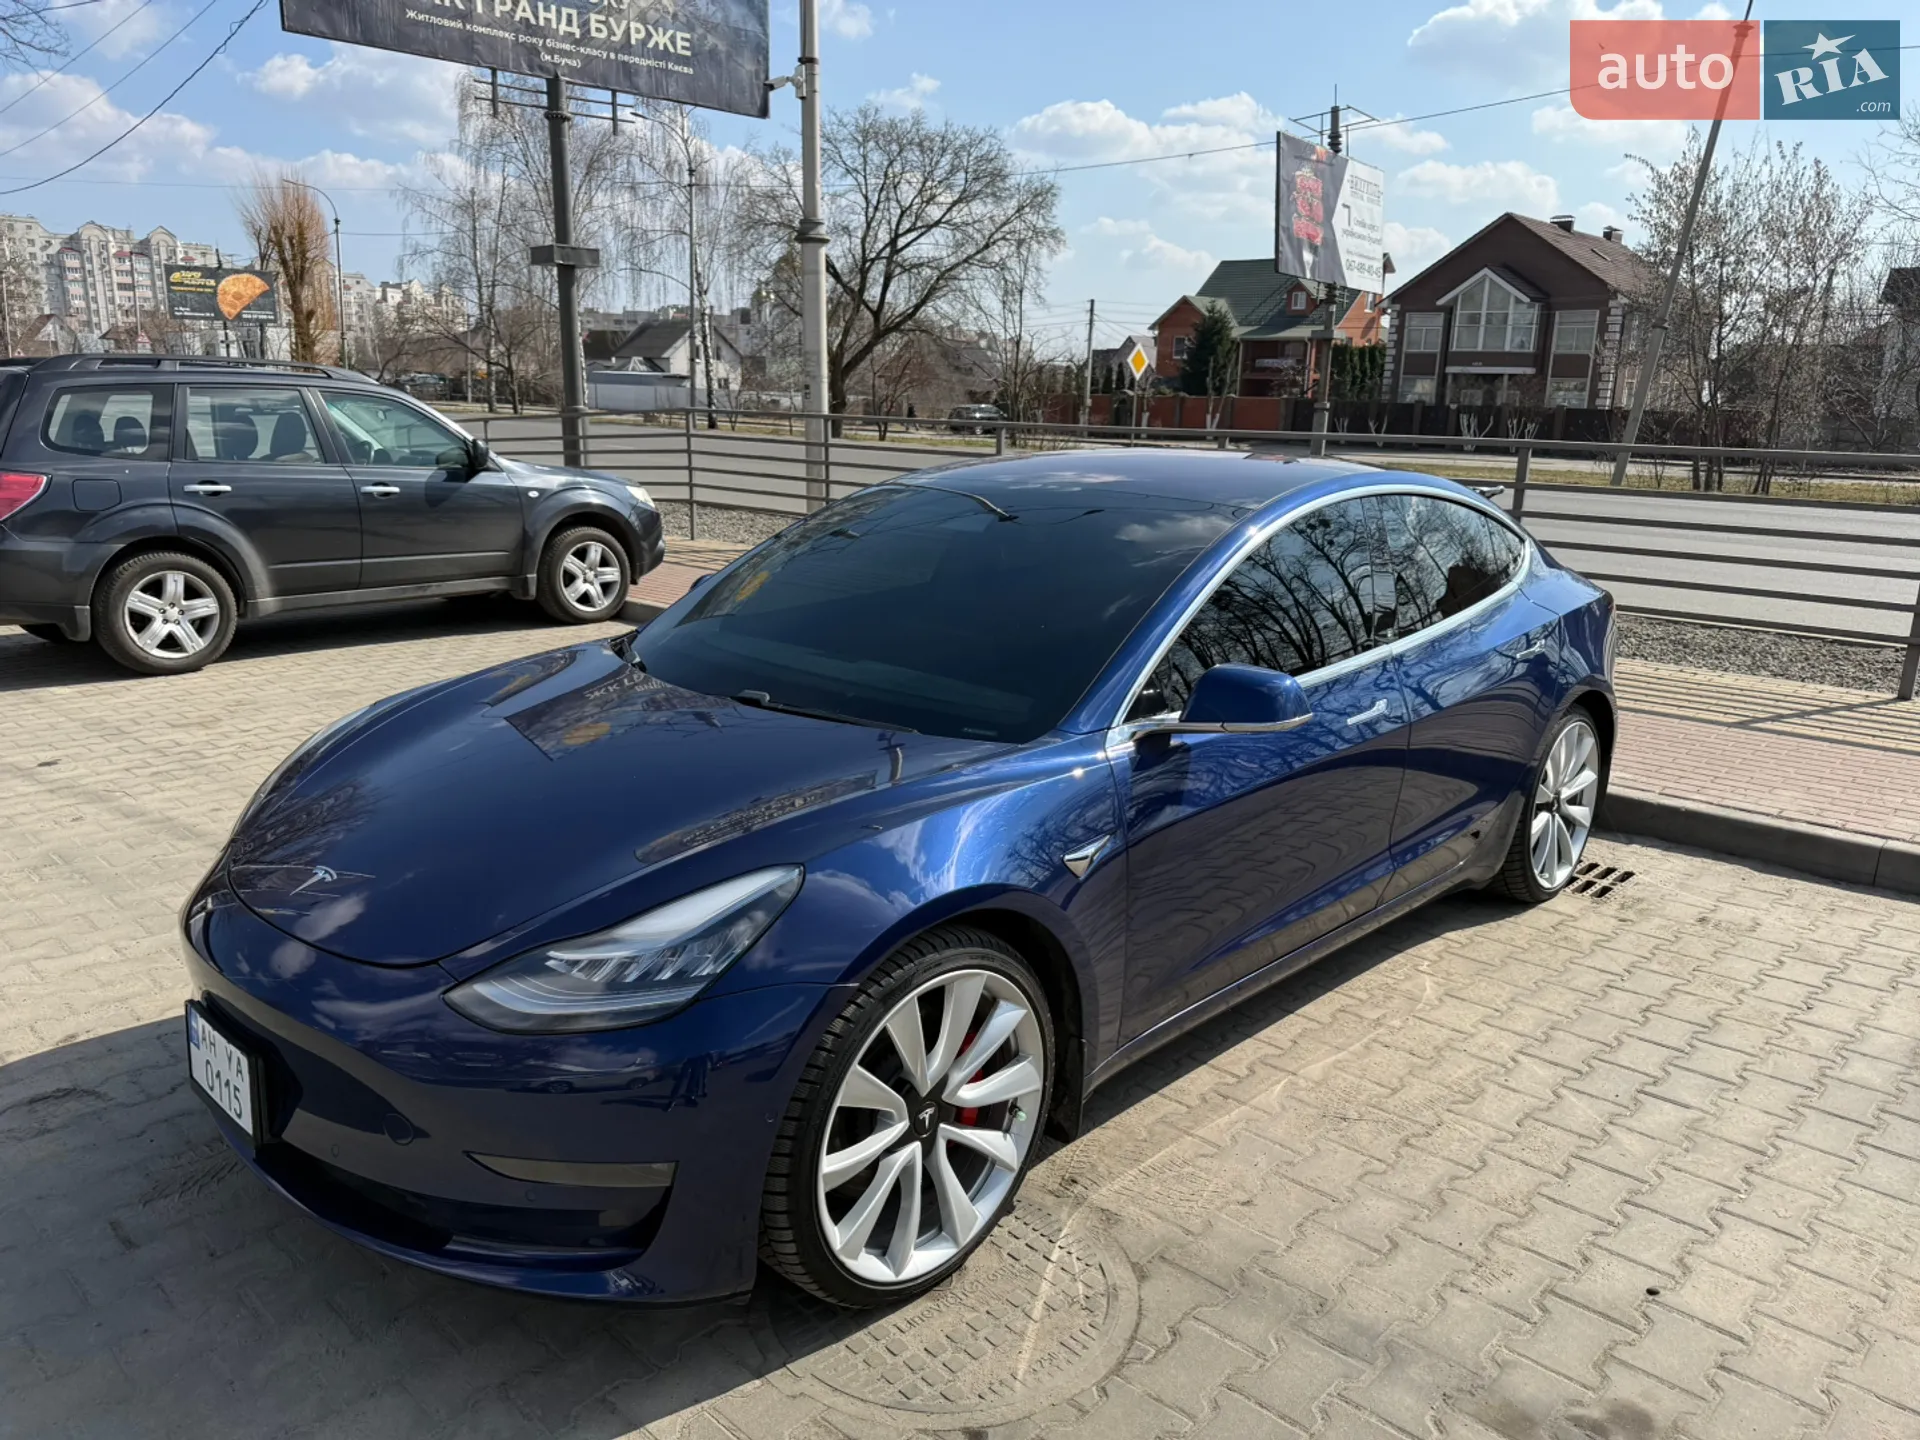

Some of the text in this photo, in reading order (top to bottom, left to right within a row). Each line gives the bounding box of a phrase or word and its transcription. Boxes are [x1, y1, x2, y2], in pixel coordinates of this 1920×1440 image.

[405, 8, 463, 29] Житловий
[465, 22, 516, 40] комплекс
[518, 34, 543, 48] року
[545, 37, 608, 60] бізнес-класу
[609, 51, 616, 60] в
[667, 62, 695, 75] Києва
[590, 12, 692, 56] БУРЖЕ
[201, 1024, 217, 1059] AH
[205, 1058, 243, 1120] 0115
